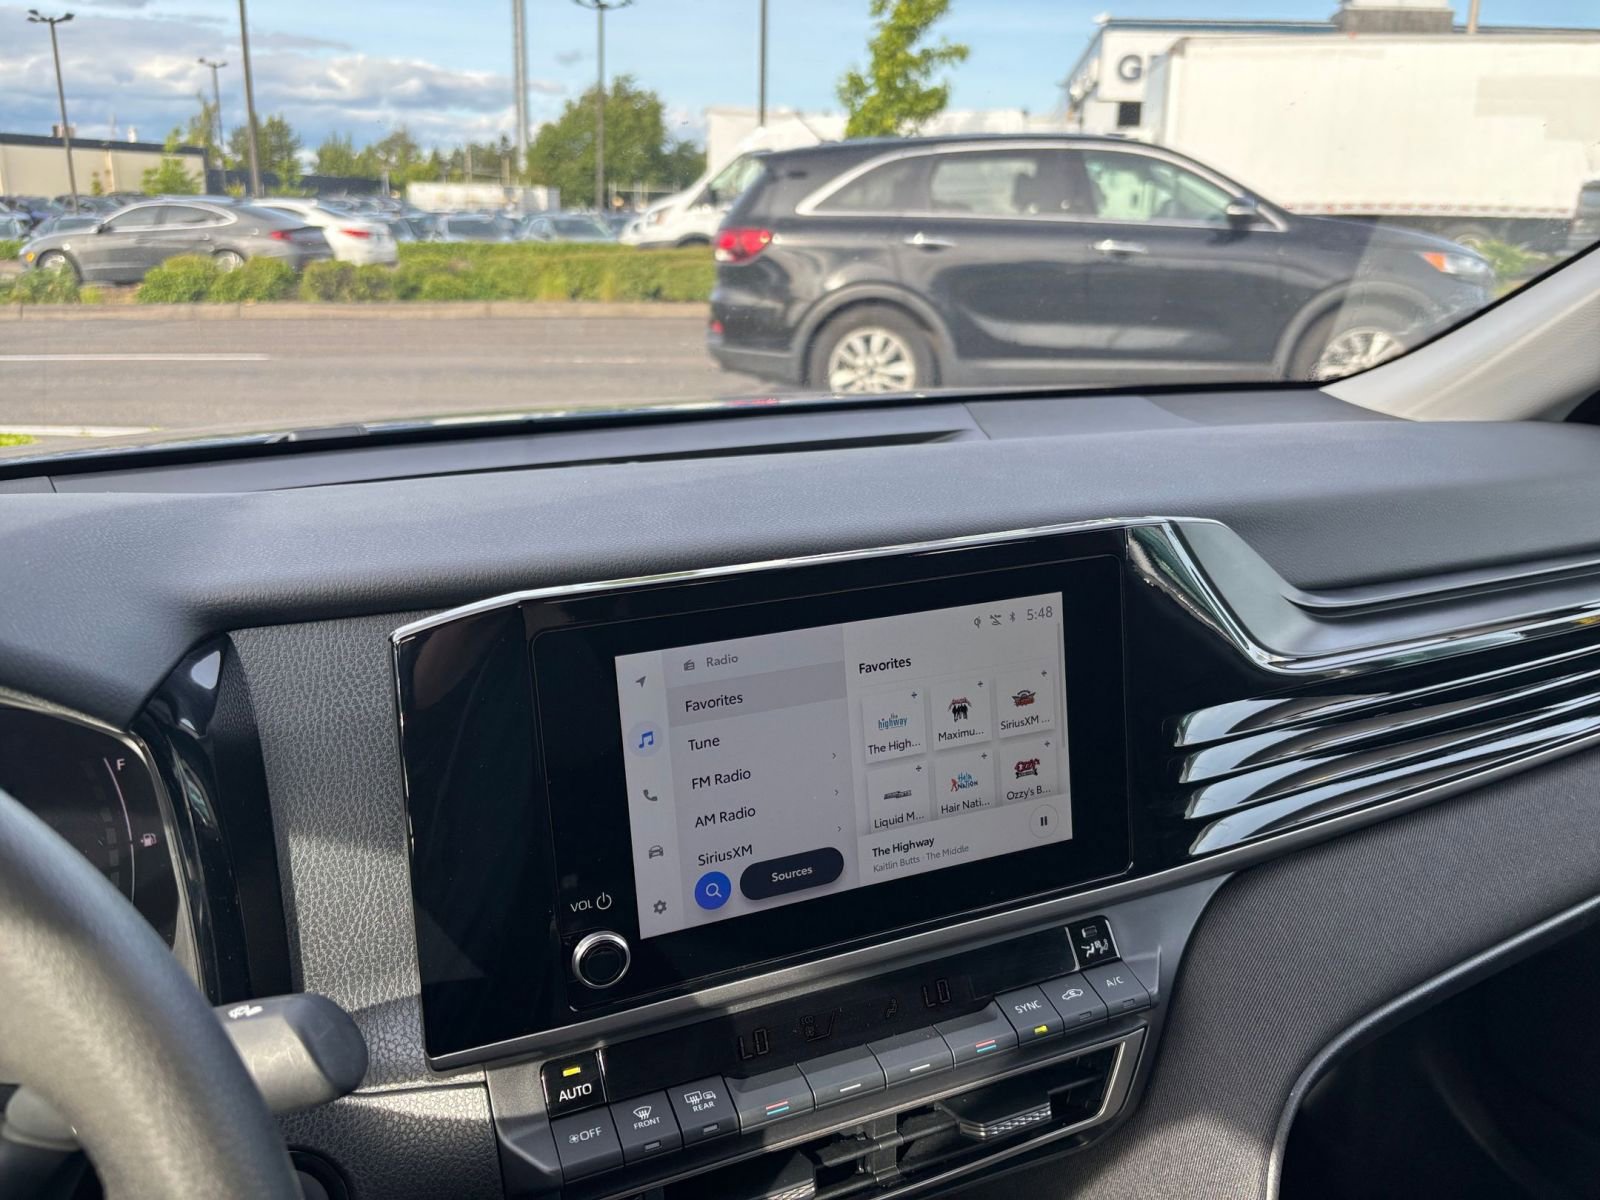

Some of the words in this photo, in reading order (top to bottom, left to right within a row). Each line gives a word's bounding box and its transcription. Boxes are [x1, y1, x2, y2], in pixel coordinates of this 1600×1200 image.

[1026, 606, 1053, 621] 5:48
[706, 653, 739, 667] Radio
[859, 656, 912, 674] Favorites
[685, 692, 744, 712] Favorites
[1000, 715, 1039, 730] SiriusXM
[687, 734, 721, 751] Tune
[867, 744, 886, 755] The
[116, 758, 125, 771] F
[692, 776, 711, 790] FM
[714, 768, 751, 785] Radio
[1006, 788, 1034, 801] Ozzy's
[941, 803, 961, 814] Hair
[695, 813, 716, 828] AM
[719, 806, 756, 823] Radio
[874, 813, 904, 829] Liquid
[698, 844, 753, 866] SiriusXM
[872, 847, 891, 857] The
[892, 838, 935, 854] Highway
[873, 861, 899, 873] Kaitlin
[900, 855, 921, 867] Butts
[925, 851, 941, 861] The
[942, 844, 969, 856] Middle
[771, 866, 813, 882] Sources
[570, 899, 593, 912] VOL
[1106, 975, 1124, 988] A/C
[1015, 999, 1042, 1015] SYNC
[559, 1082, 593, 1102] AUTO
[693, 1100, 715, 1112] REAR
[634, 1116, 661, 1129] FRONT
[580, 1126, 602, 1142] OFF
